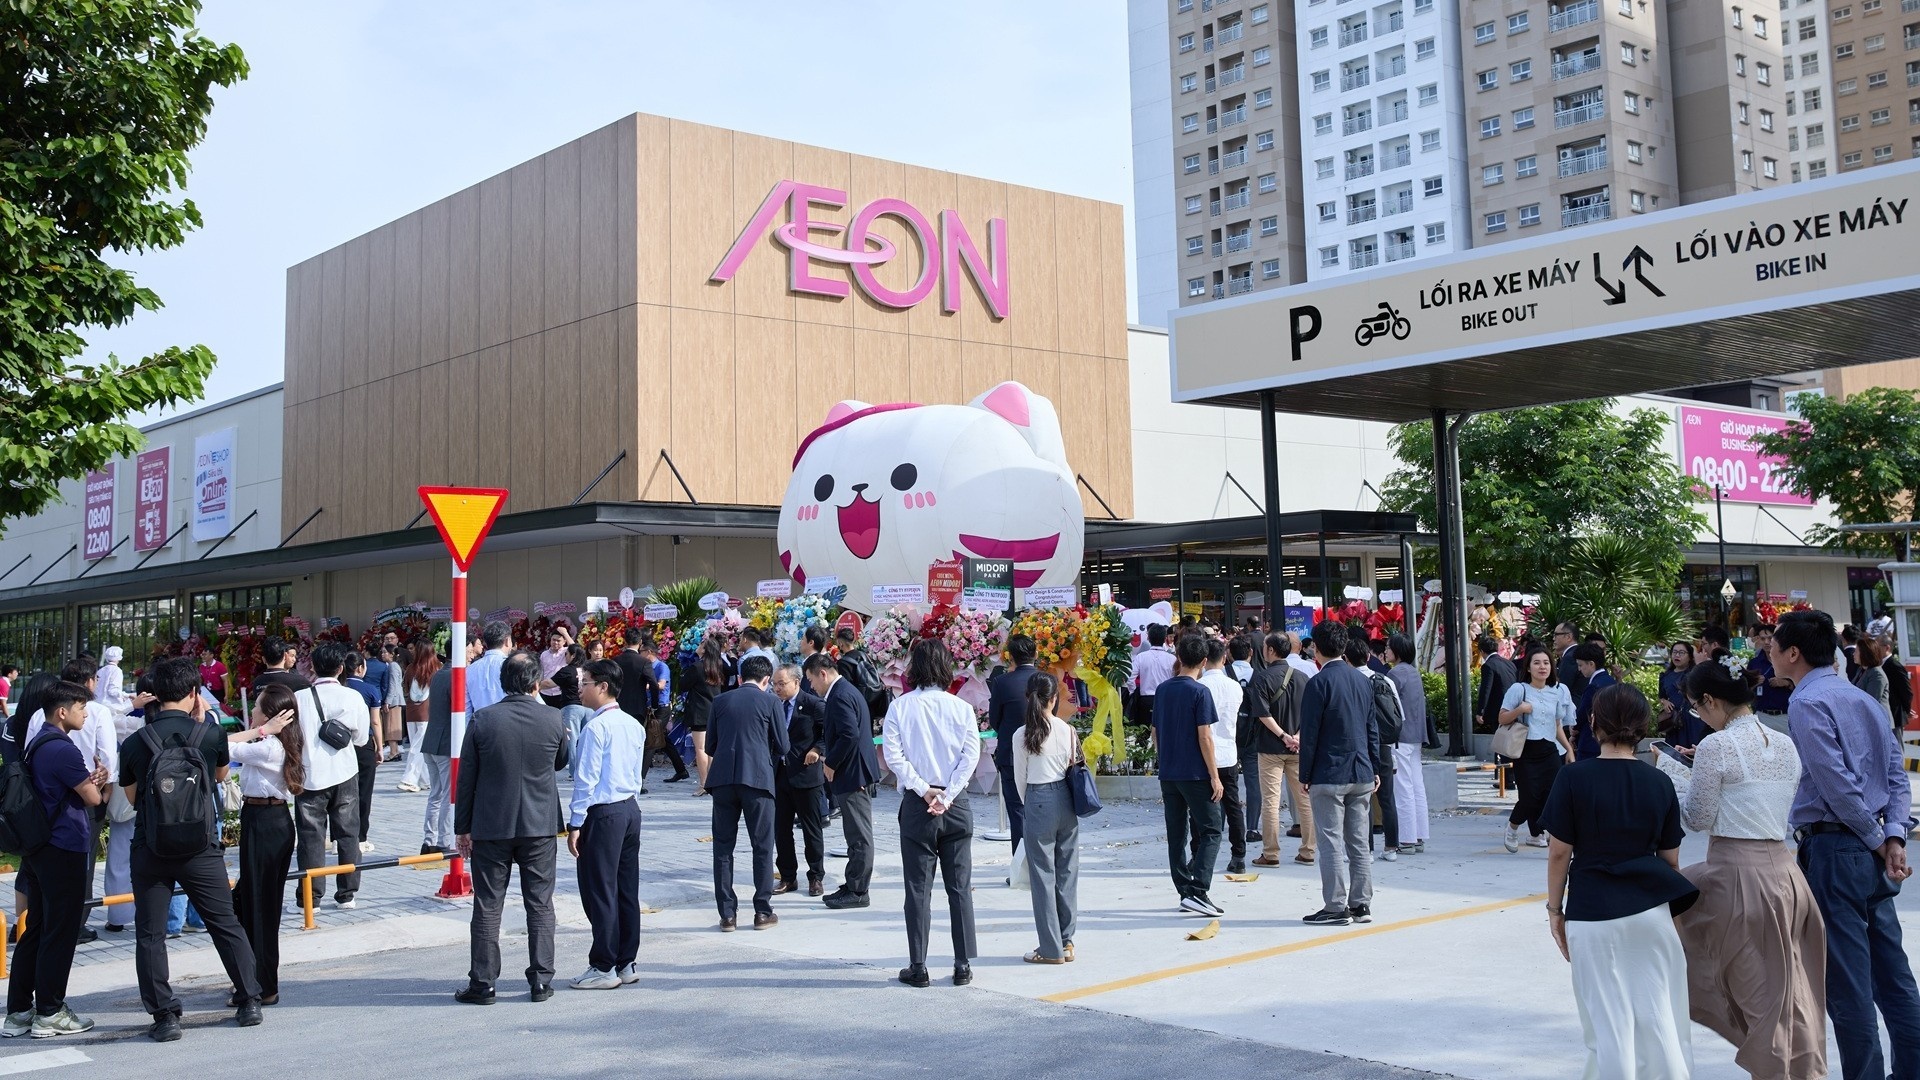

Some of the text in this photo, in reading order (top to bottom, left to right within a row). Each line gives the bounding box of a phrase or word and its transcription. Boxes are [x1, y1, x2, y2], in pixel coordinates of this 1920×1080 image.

[1675, 197, 1909, 263] LỐI VÀO XE MÁY
[1756, 252, 1827, 281] BIKE IN
[1419, 258, 1581, 310] LỐI RA XE MÁY
[1461, 303, 1538, 331] BIKE OUT
[1289, 305, 1322, 361] P
[1720, 419, 1735, 435] GIỜ
[1735, 422, 1756, 439] HOẠT
[1721, 438, 1756, 452] BUSINESS
[1692, 455, 1747, 491] 08:00
[87, 505, 111, 530] 08:00
[87, 530, 110, 555] 22:00
[976, 563, 1008, 573] MIDORI
